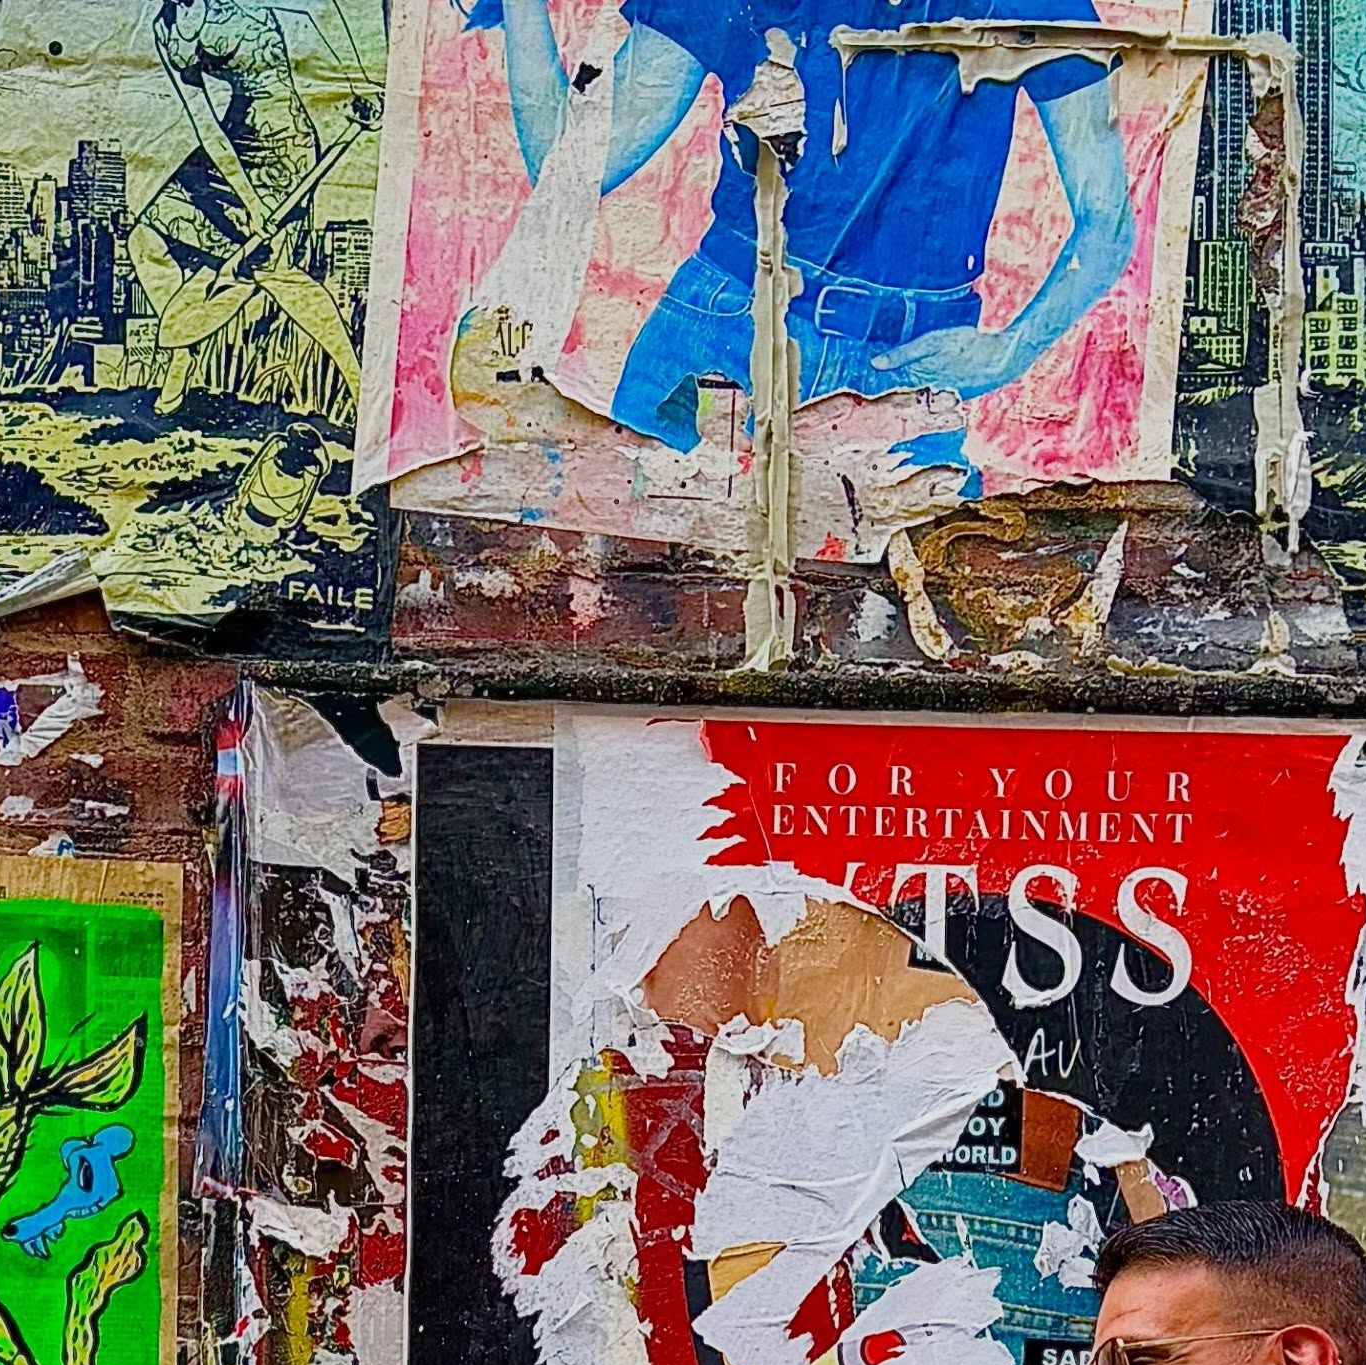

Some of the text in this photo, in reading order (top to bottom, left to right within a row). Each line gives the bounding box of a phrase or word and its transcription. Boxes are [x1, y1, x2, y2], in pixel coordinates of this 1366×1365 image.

[289, 581, 374, 610] FAILE
[773, 762, 1191, 803] FOR YOUR
[772, 804, 1193, 844] ENTERTAINMENT
[968, 1117, 1006, 1137] OY
